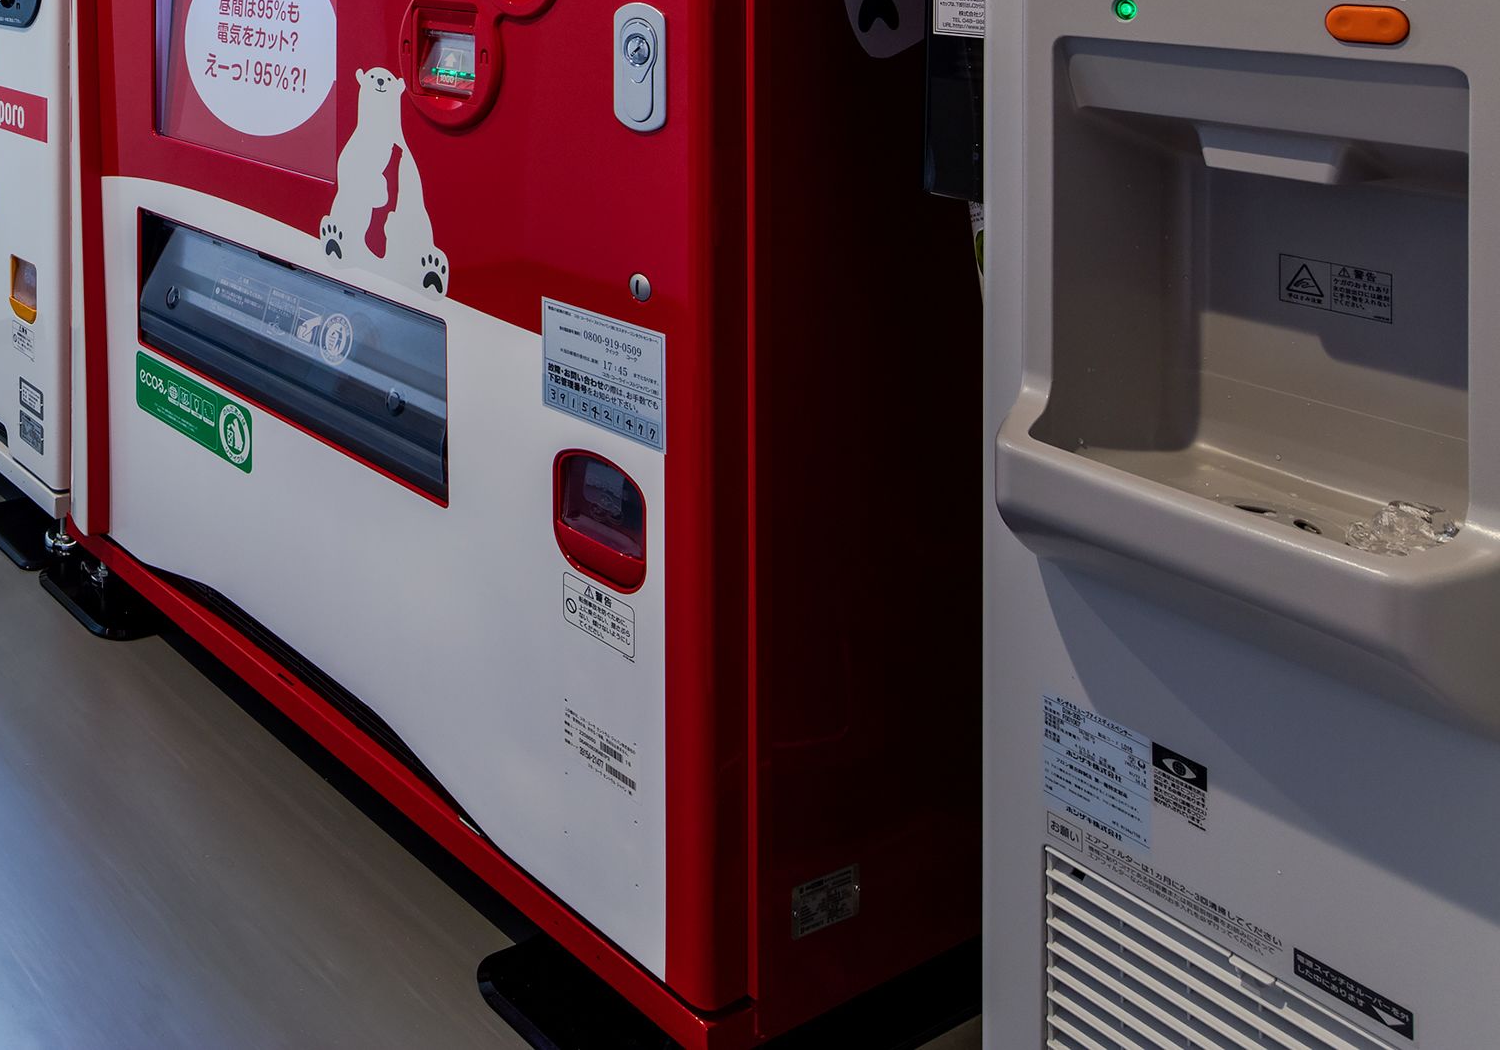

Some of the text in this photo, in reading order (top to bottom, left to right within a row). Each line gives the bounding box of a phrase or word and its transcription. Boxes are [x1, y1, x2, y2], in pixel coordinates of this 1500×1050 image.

[217, 21, 299, 52] 電気をカット?
[583, 330, 642, 357] 0800-919-0509
[1050, 819, 1080, 844] お願い
